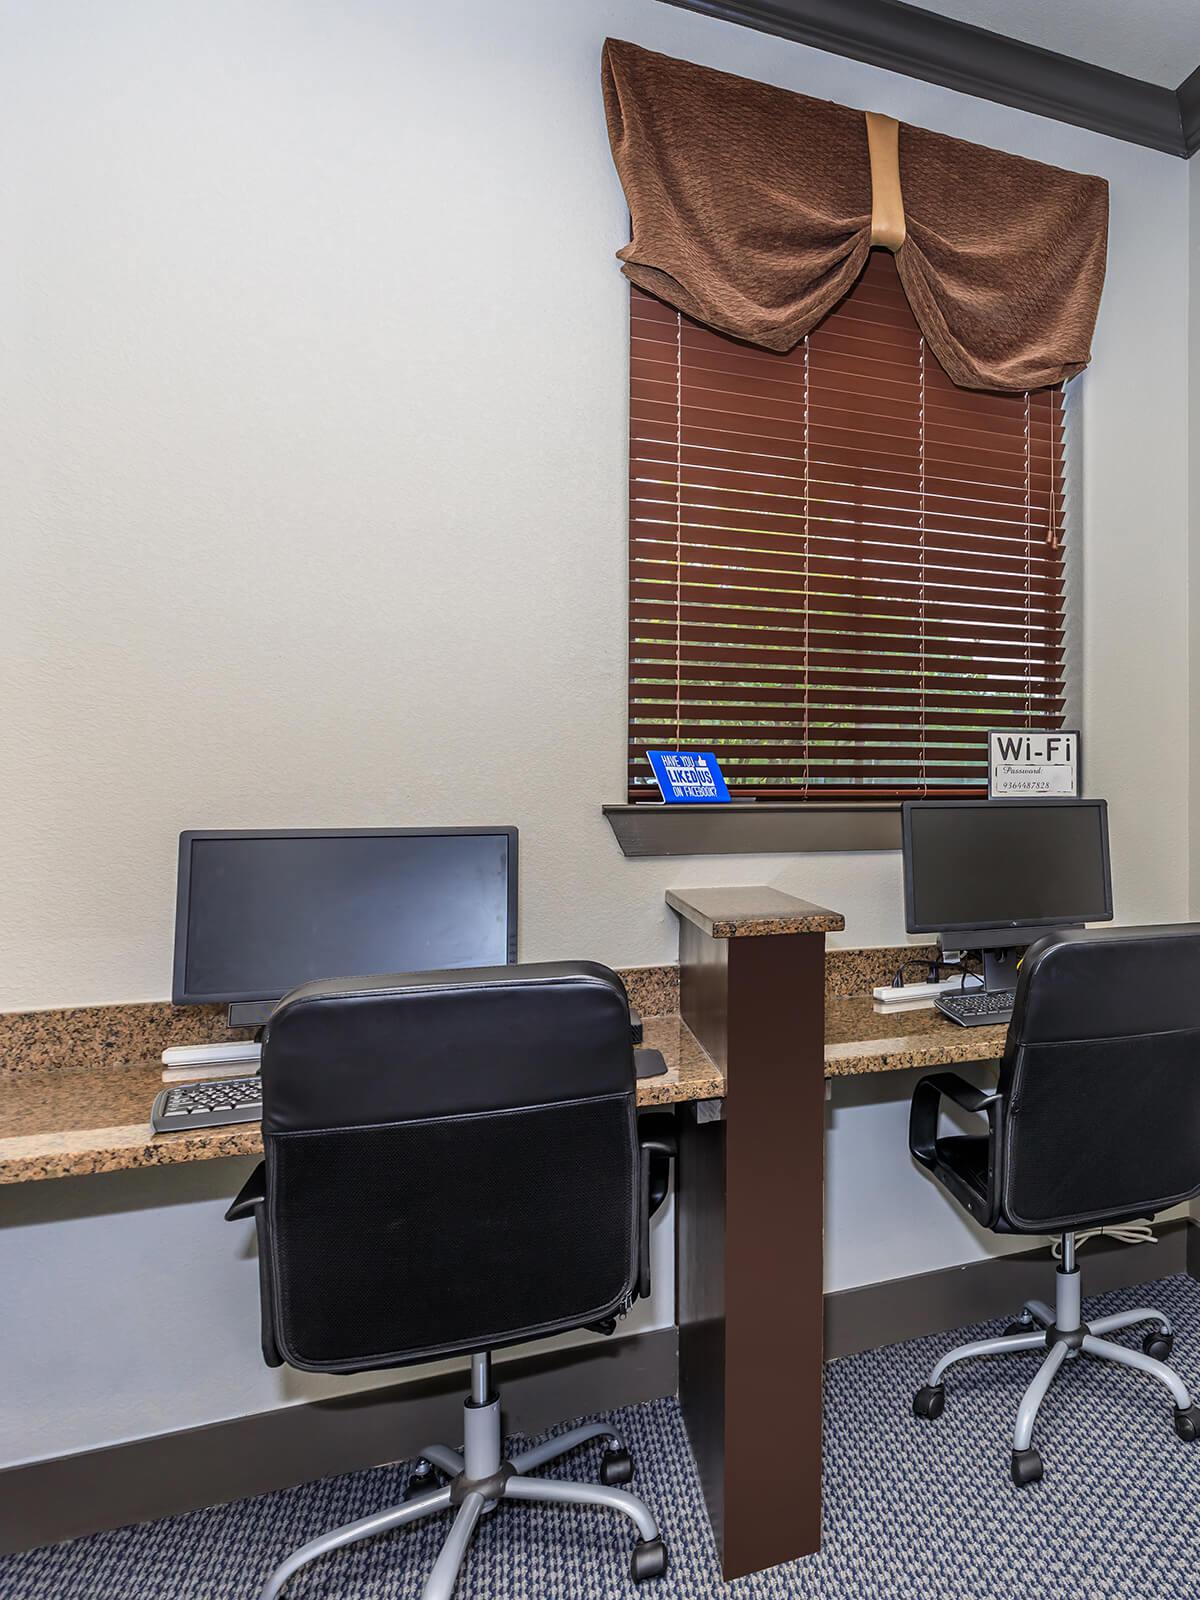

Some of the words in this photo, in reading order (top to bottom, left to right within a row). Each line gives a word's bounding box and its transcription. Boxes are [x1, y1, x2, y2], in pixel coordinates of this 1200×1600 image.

[997, 737, 1071, 761] Wi-Fi
[661, 755, 680, 767] HAVE
[680, 755, 695, 767] YOU
[667, 769, 698, 783] LIKED
[699, 770, 713, 783] US
[673, 786, 684, 797] ON
